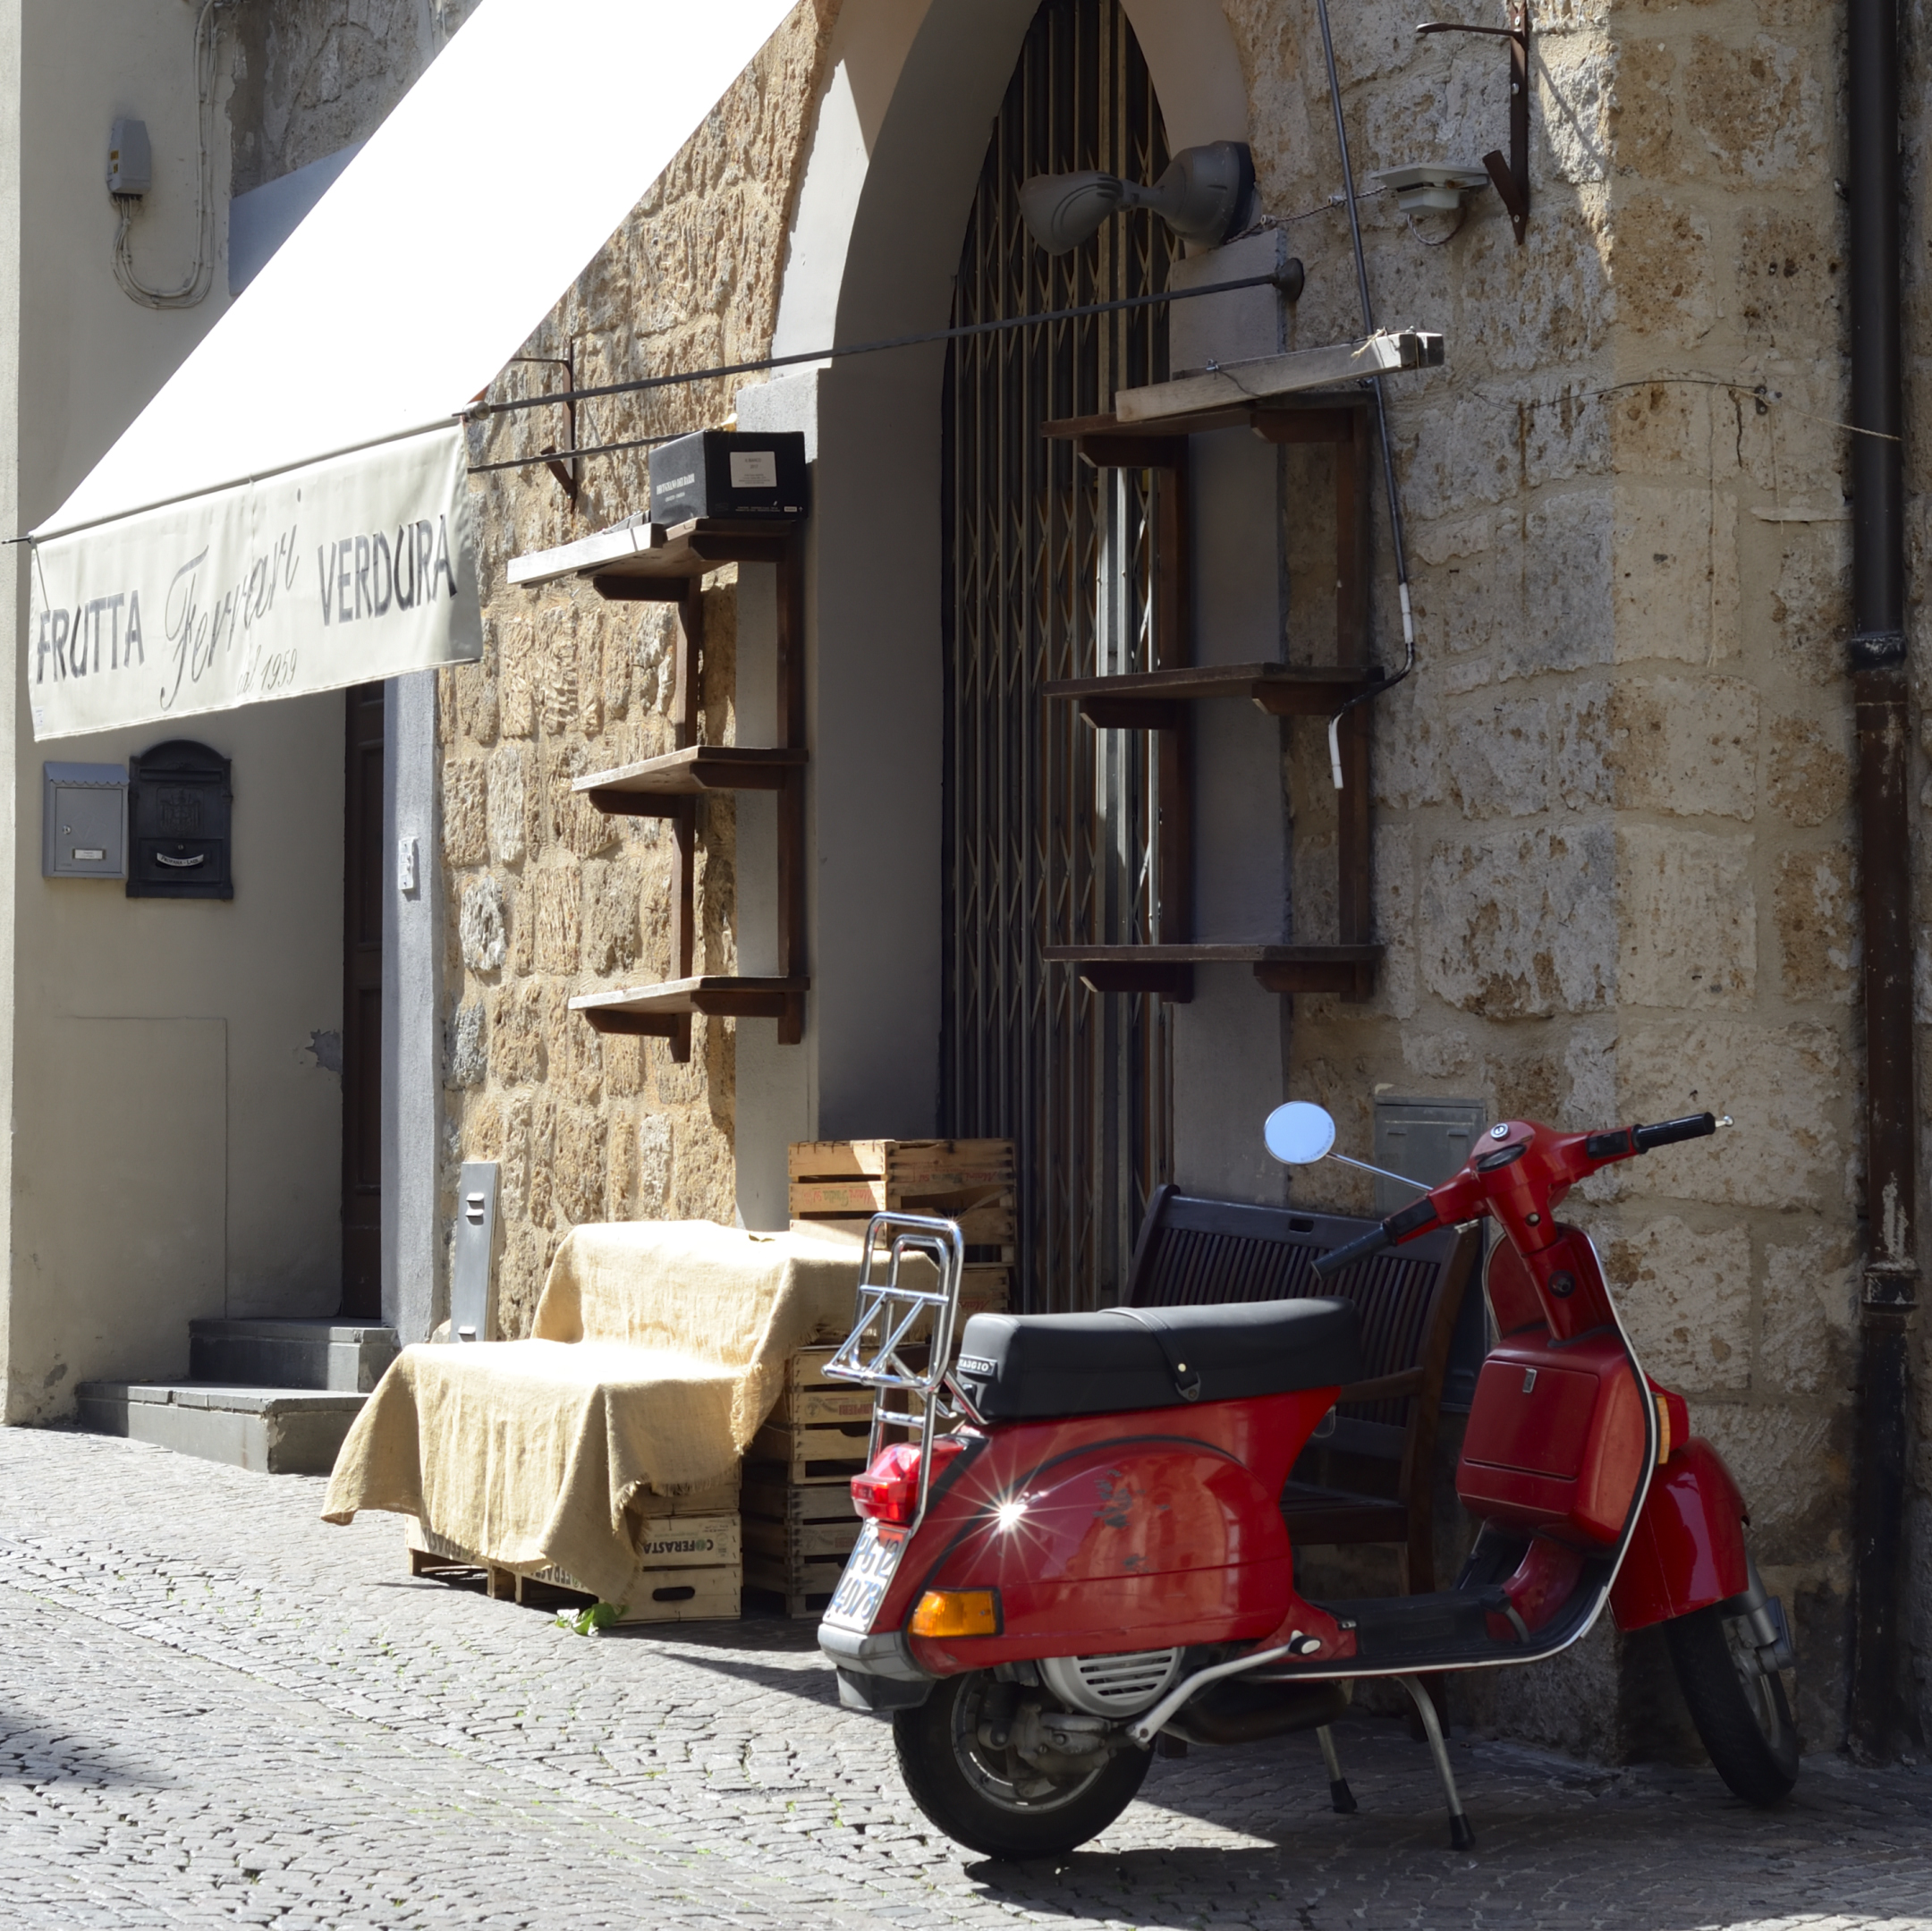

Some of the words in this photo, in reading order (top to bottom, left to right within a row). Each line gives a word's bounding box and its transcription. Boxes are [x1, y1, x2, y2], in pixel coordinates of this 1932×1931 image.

[37, 589, 145, 685] FRUTTA
[159, 487, 301, 712] Ferrari
[317, 512, 459, 626] VERDURA
[260, 648, 298, 691] 1959
